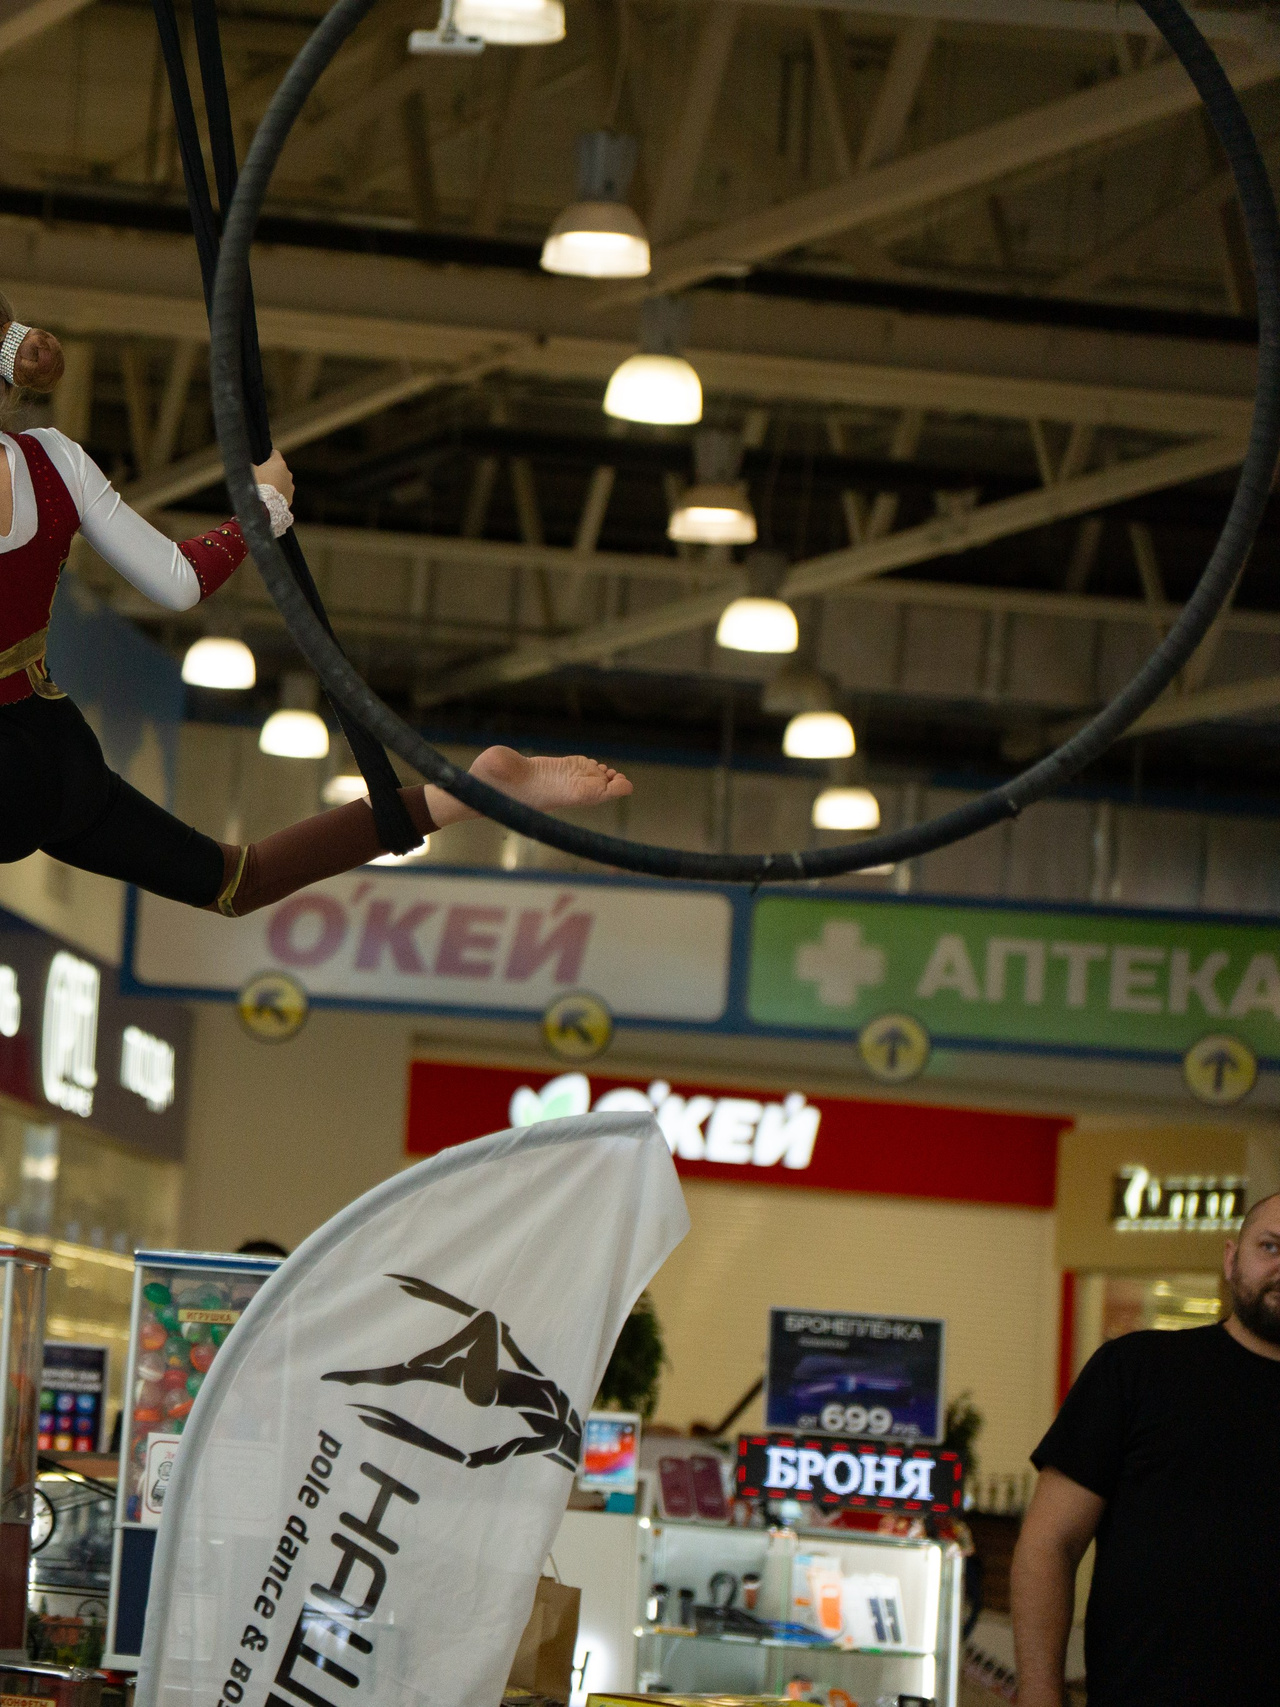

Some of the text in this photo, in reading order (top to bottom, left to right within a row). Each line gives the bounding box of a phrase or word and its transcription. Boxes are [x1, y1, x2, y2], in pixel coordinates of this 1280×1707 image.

[917, 933, 1280, 1019] АПТЕКА
[186, 1310, 232, 1322] ИГРУШКА
[821, 1403, 893, 1436] 699
[297, 1429, 343, 1509] pole
[763, 1445, 937, 1501] БРОНЯ
[253, 1514, 310, 1620] dance
[264, 1461, 421, 1707] НАШ
[240, 1624, 269, 1653] &
